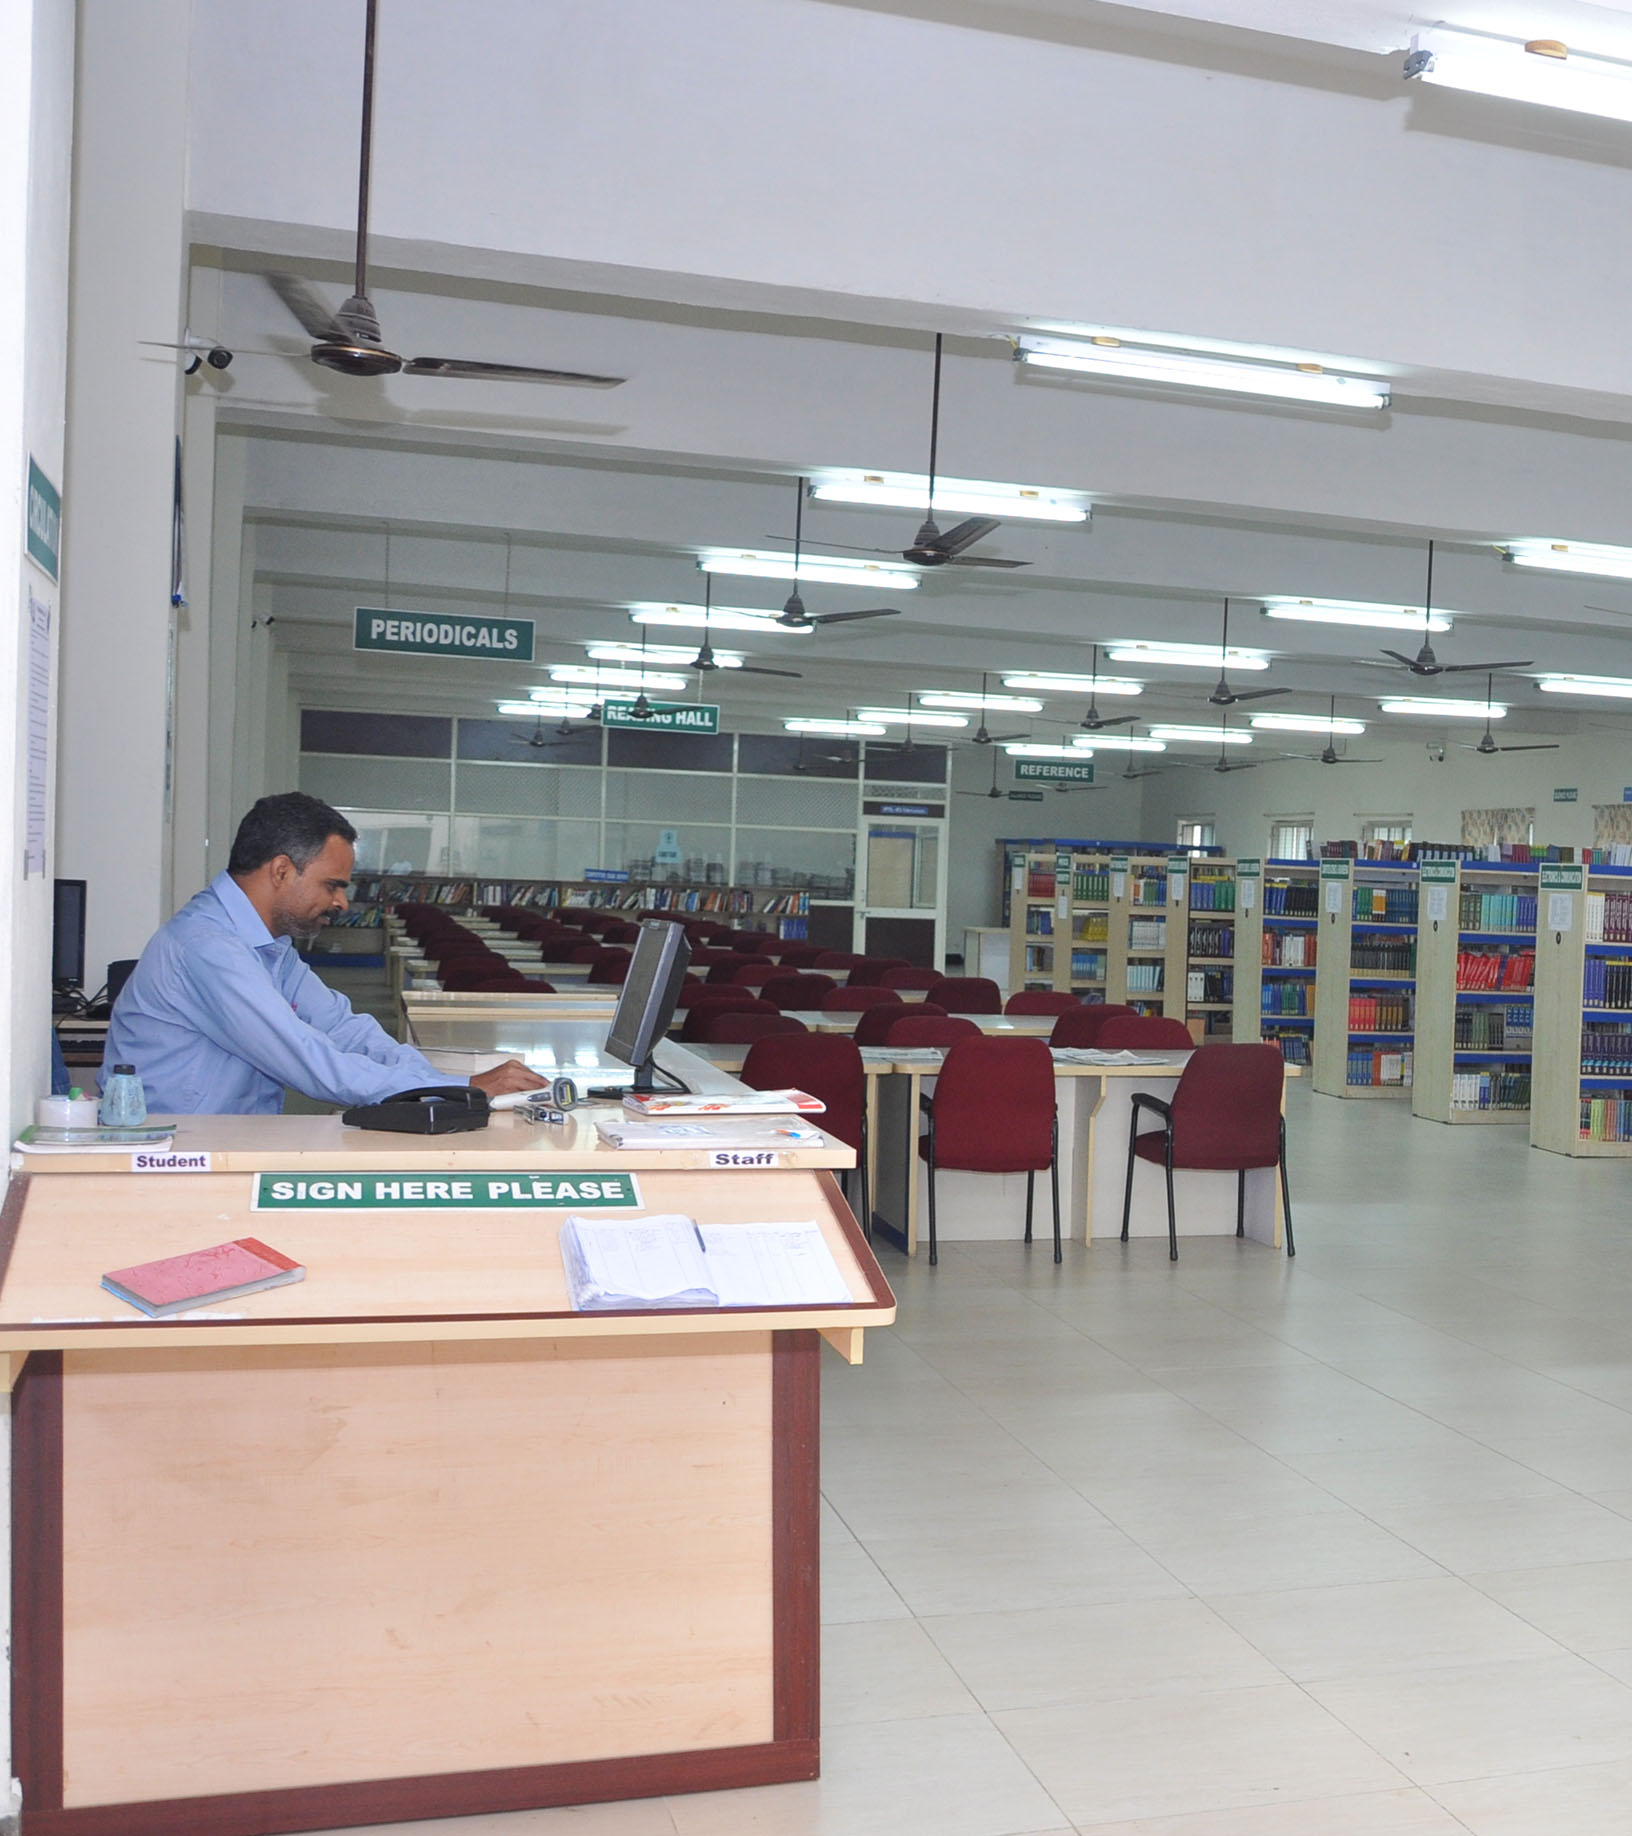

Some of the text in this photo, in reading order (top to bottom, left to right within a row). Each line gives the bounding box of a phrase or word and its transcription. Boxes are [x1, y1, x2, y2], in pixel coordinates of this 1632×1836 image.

[371, 619, 518, 650] PERIODICALS
[606, 705, 713, 727] REAING HALL
[1020, 764, 1089, 778] REFERENCE
[136, 1154, 206, 1168] Student
[715, 1153, 775, 1166] Staff
[271, 1181, 625, 1200] SIGN HERE PLEASE
